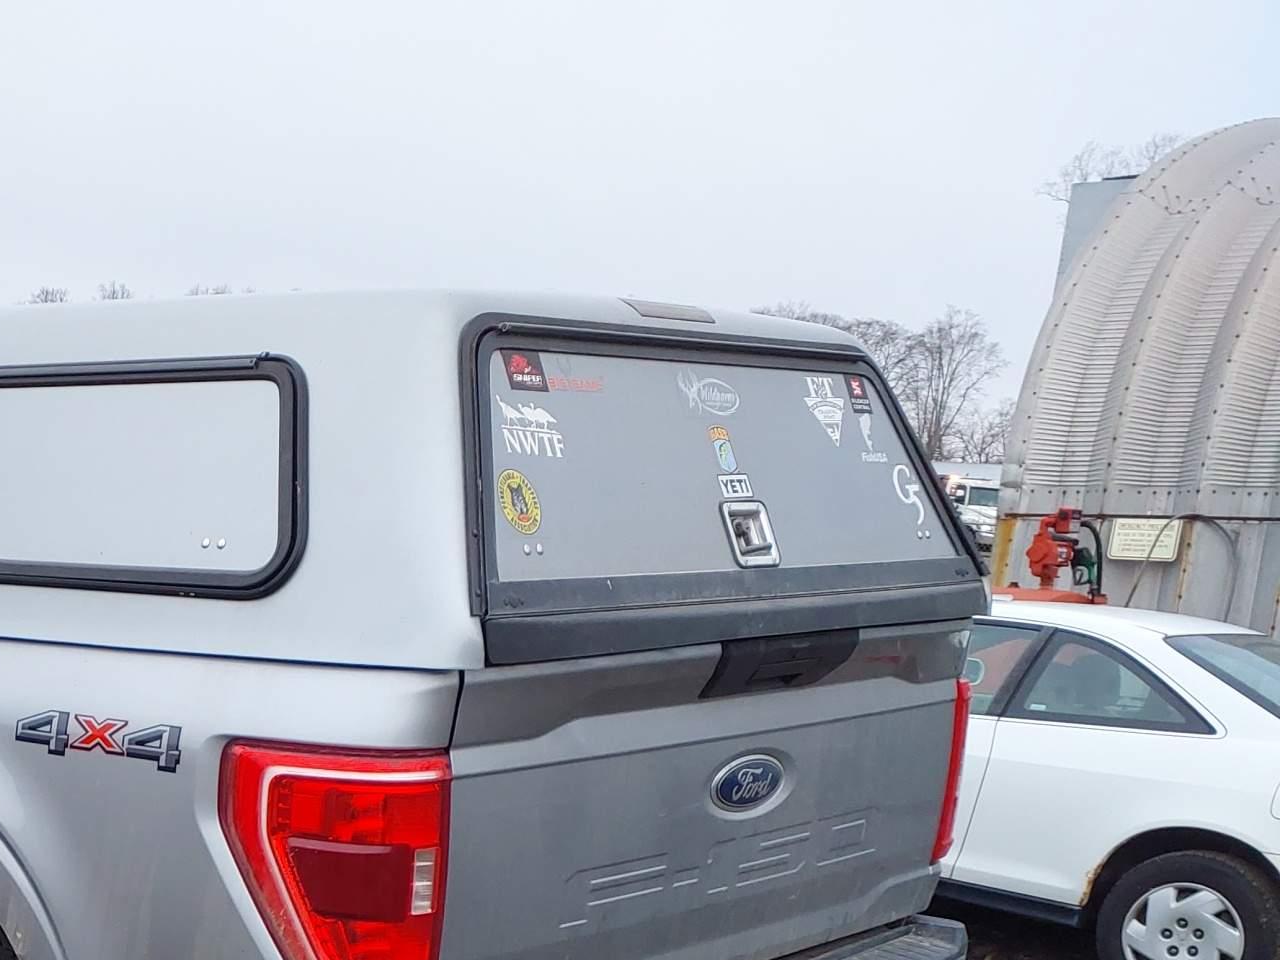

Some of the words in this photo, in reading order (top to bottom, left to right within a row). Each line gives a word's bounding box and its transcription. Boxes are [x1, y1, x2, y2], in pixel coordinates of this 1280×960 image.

[501, 428, 564, 458] NWTF
[721, 479, 750, 493] YETI
[732, 767, 772, 800] Ford
